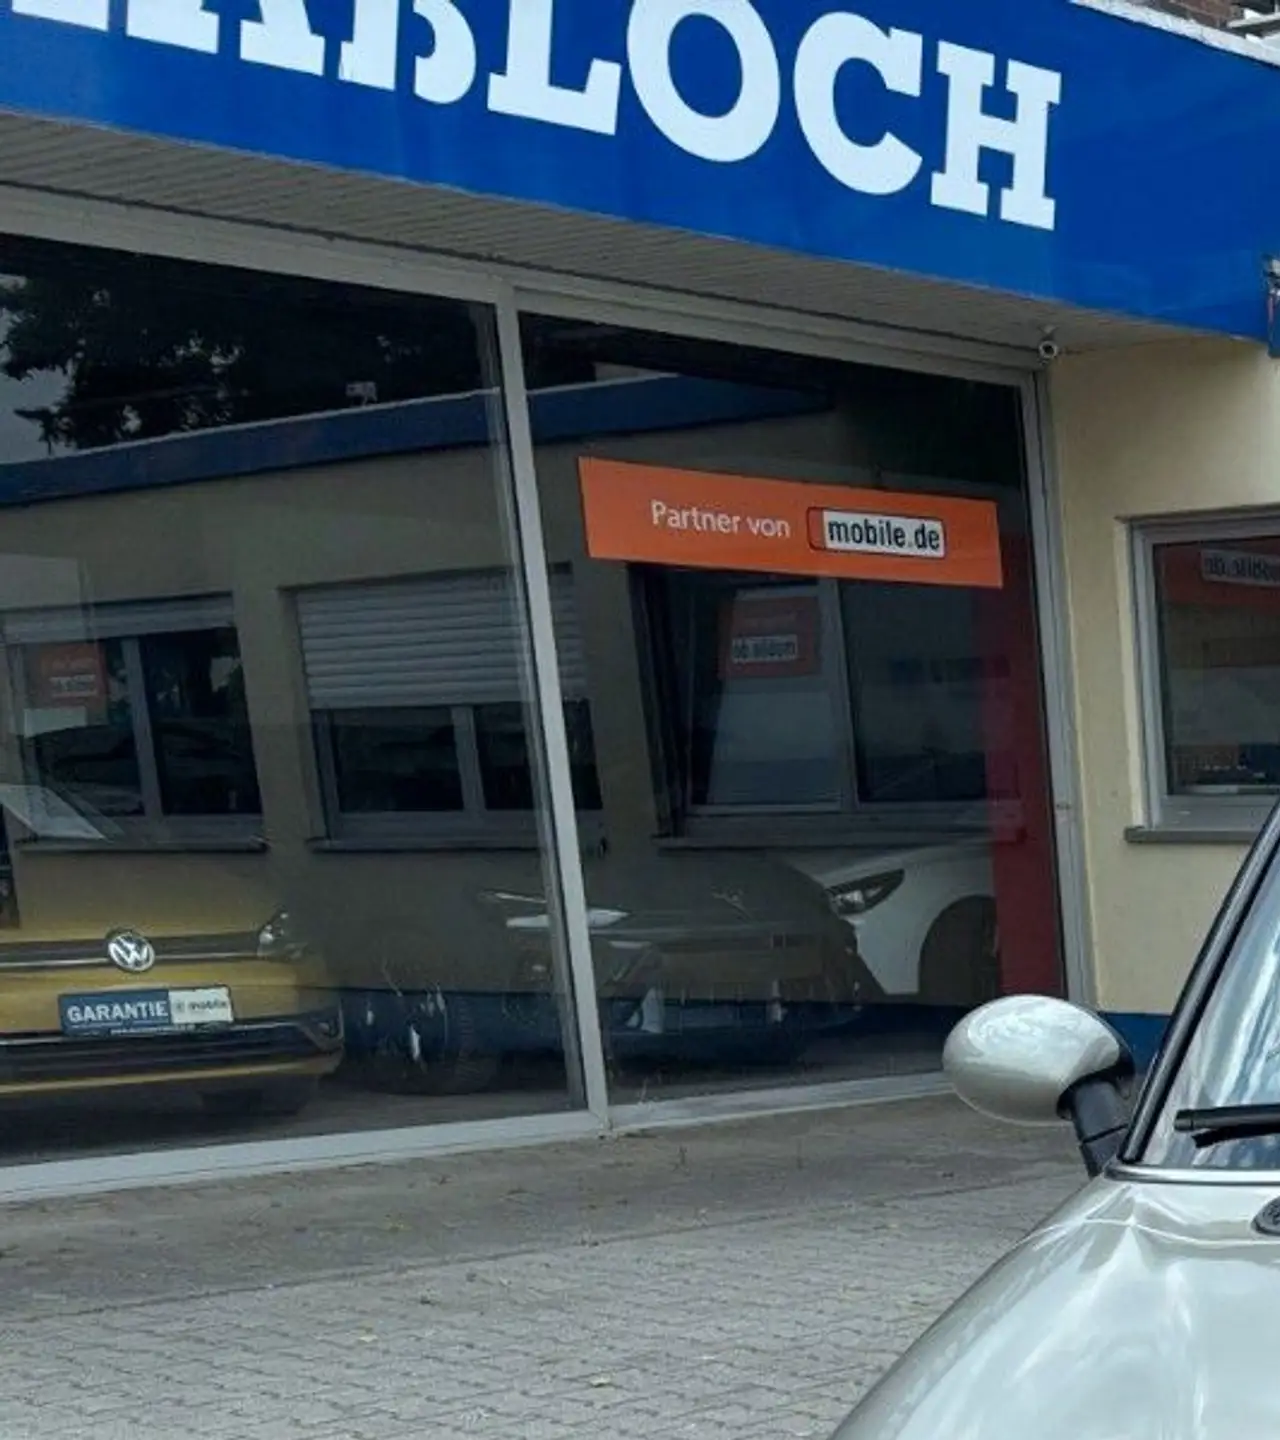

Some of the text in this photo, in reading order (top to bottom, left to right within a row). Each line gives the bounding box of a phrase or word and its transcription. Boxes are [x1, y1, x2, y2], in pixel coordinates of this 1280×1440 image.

[650, 499, 940, 551] Partner von mobile.de
[67, 1001, 169, 1023] GARANTIE
